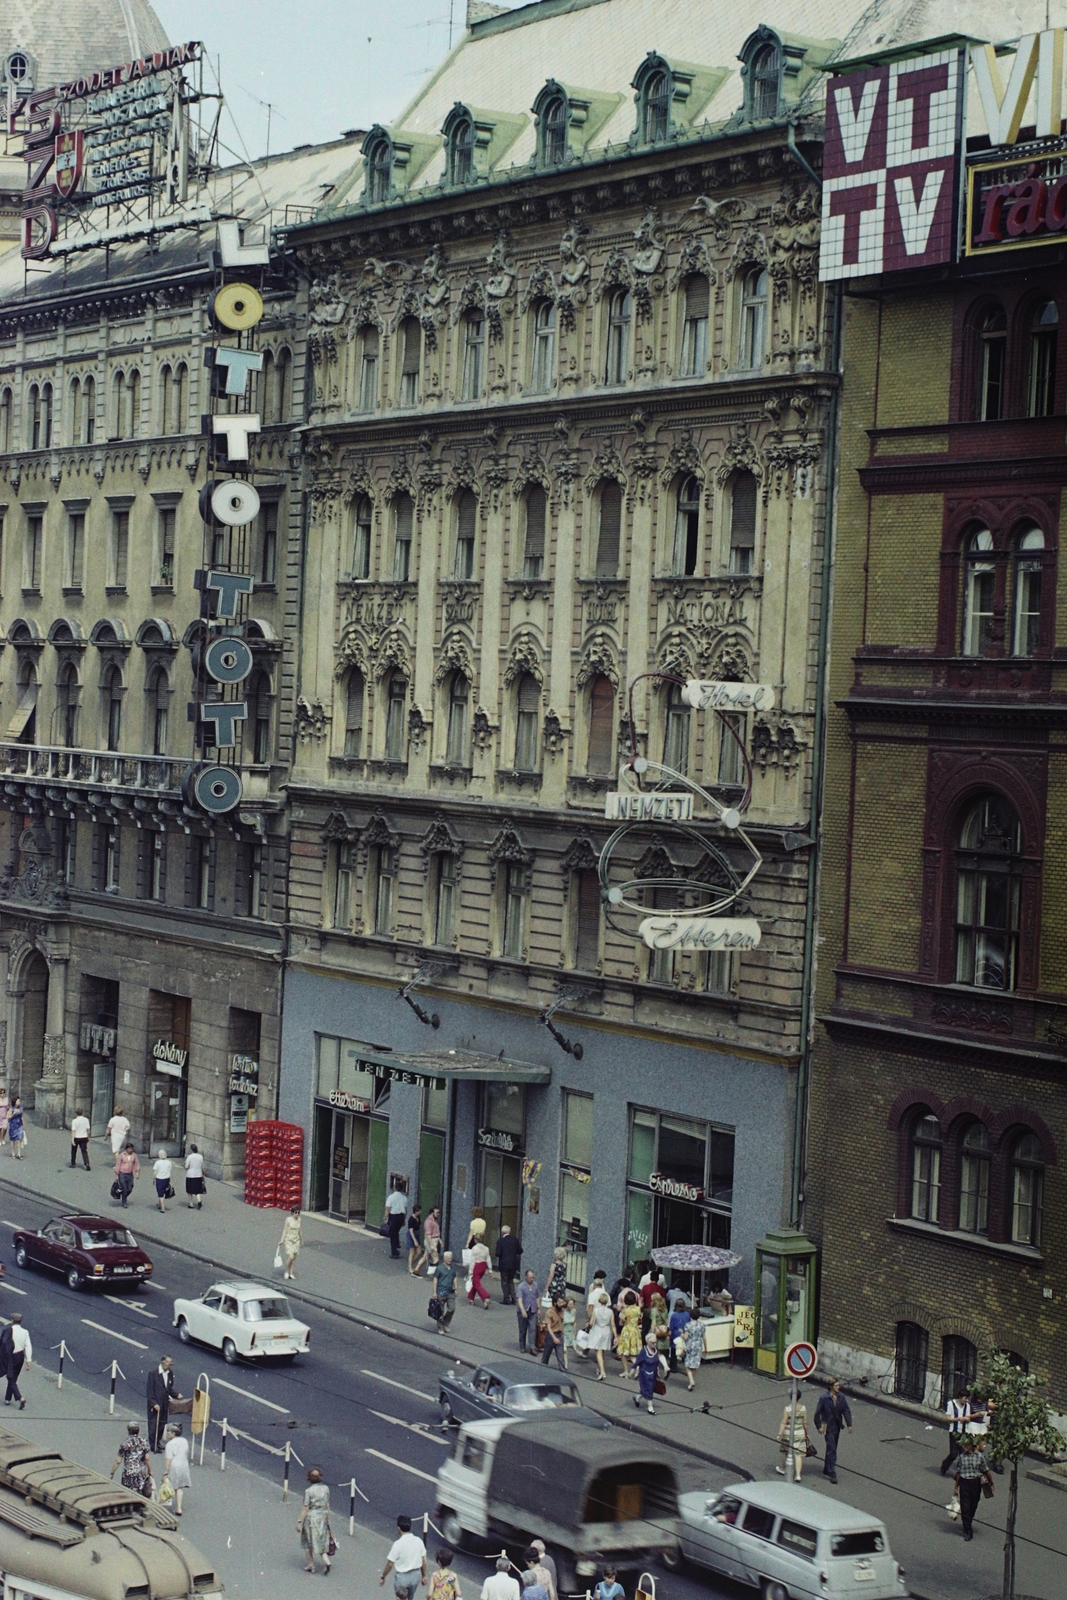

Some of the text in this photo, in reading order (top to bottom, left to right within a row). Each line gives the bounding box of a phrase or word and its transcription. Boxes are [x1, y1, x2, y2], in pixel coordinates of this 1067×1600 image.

[57, 67, 122, 103] SZOVJET
[345, 601, 408, 622] NEMZETI
[586, 600, 748, 623] HOTEL NATIONAL
[698, 684, 767, 711] Hotel
[616, 796, 693, 819] NEMZETI
[79, 1022, 116, 1057] OTP
